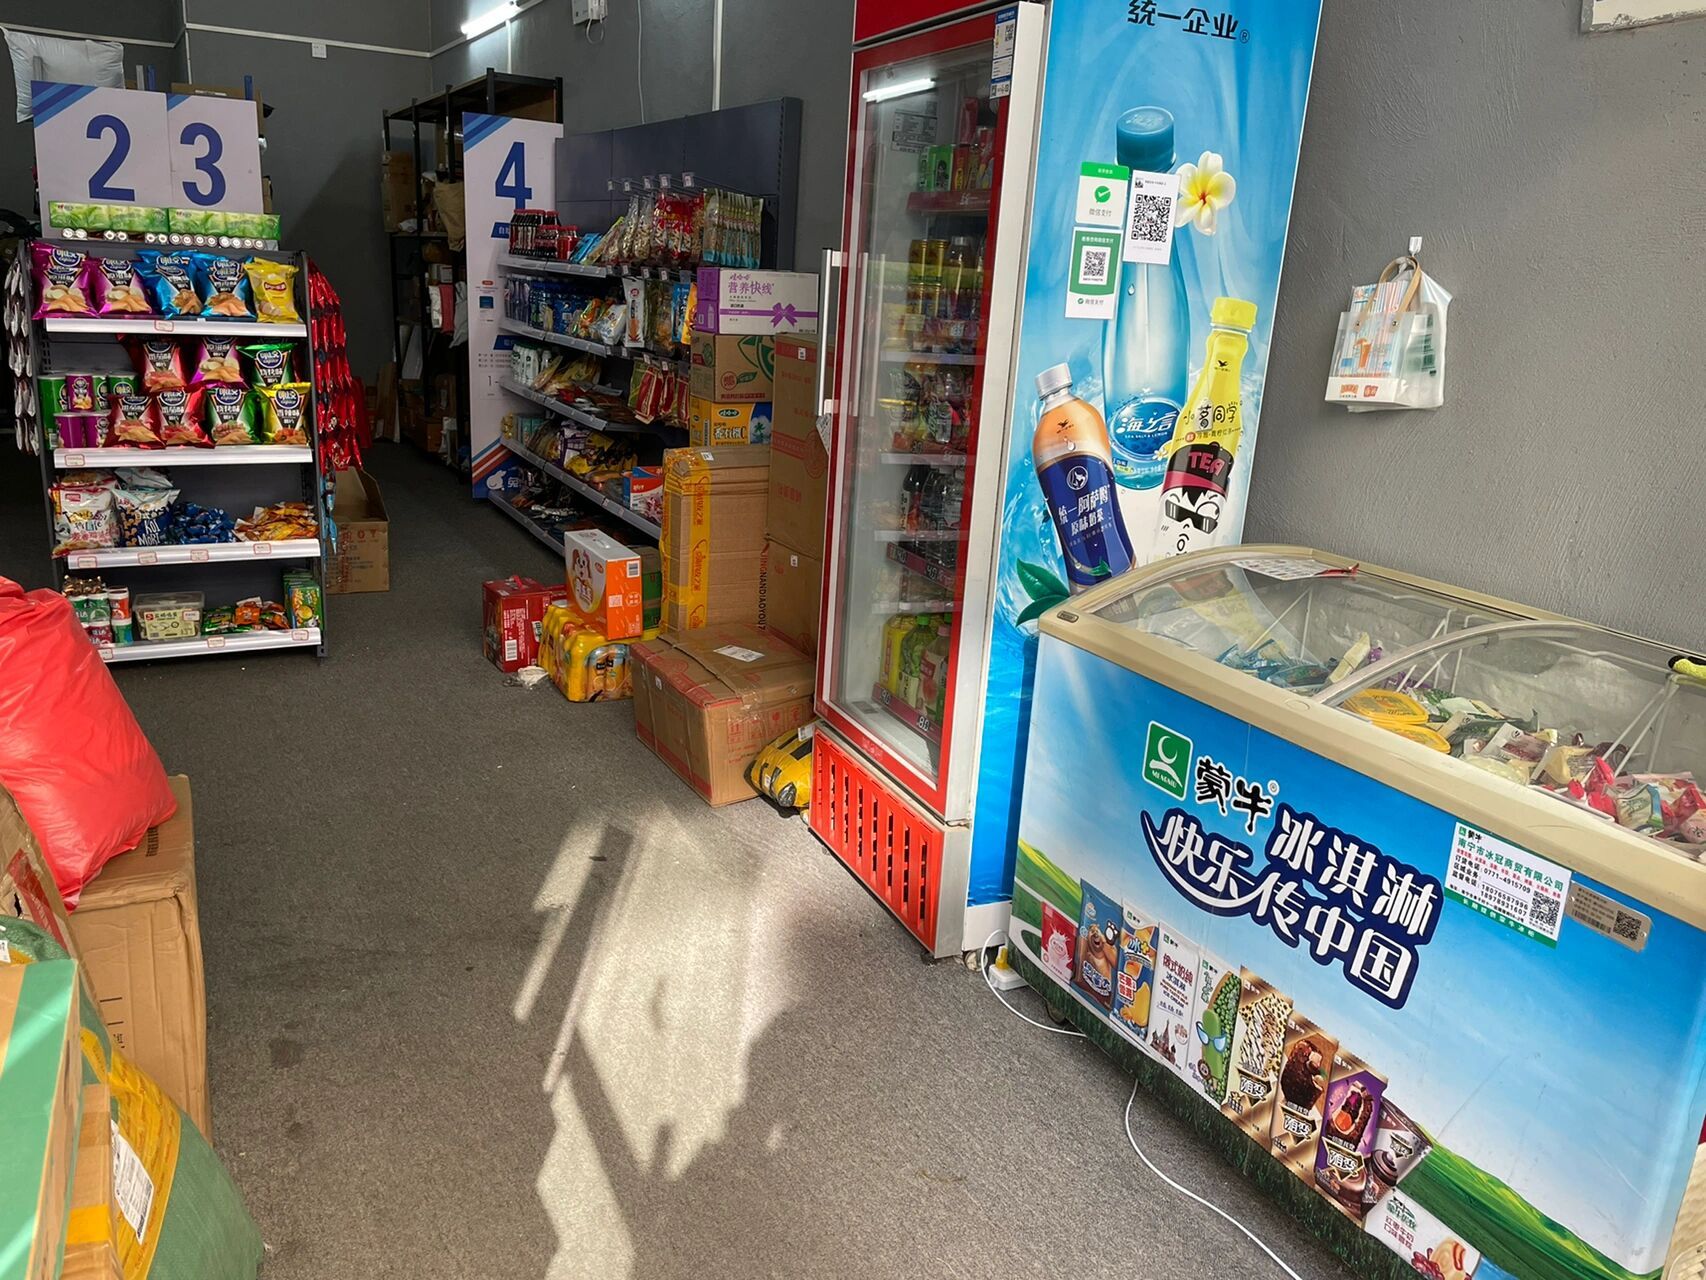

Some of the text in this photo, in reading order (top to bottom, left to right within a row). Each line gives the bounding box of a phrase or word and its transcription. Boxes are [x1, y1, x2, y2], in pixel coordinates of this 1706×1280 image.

[1127, 0, 1237, 40] 统一企业
[86, 114, 135, 201] 2
[180, 122, 226, 206] 3
[495, 141, 532, 210] 4
[728, 281, 772, 295] 营养快线
[1188, 451, 1226, 476] TEA
[1196, 758, 1272, 833] 蒙牛
[1155, 814, 1412, 1001] 快乐传中国
[1270, 809, 1438, 936] 冰淇淋
